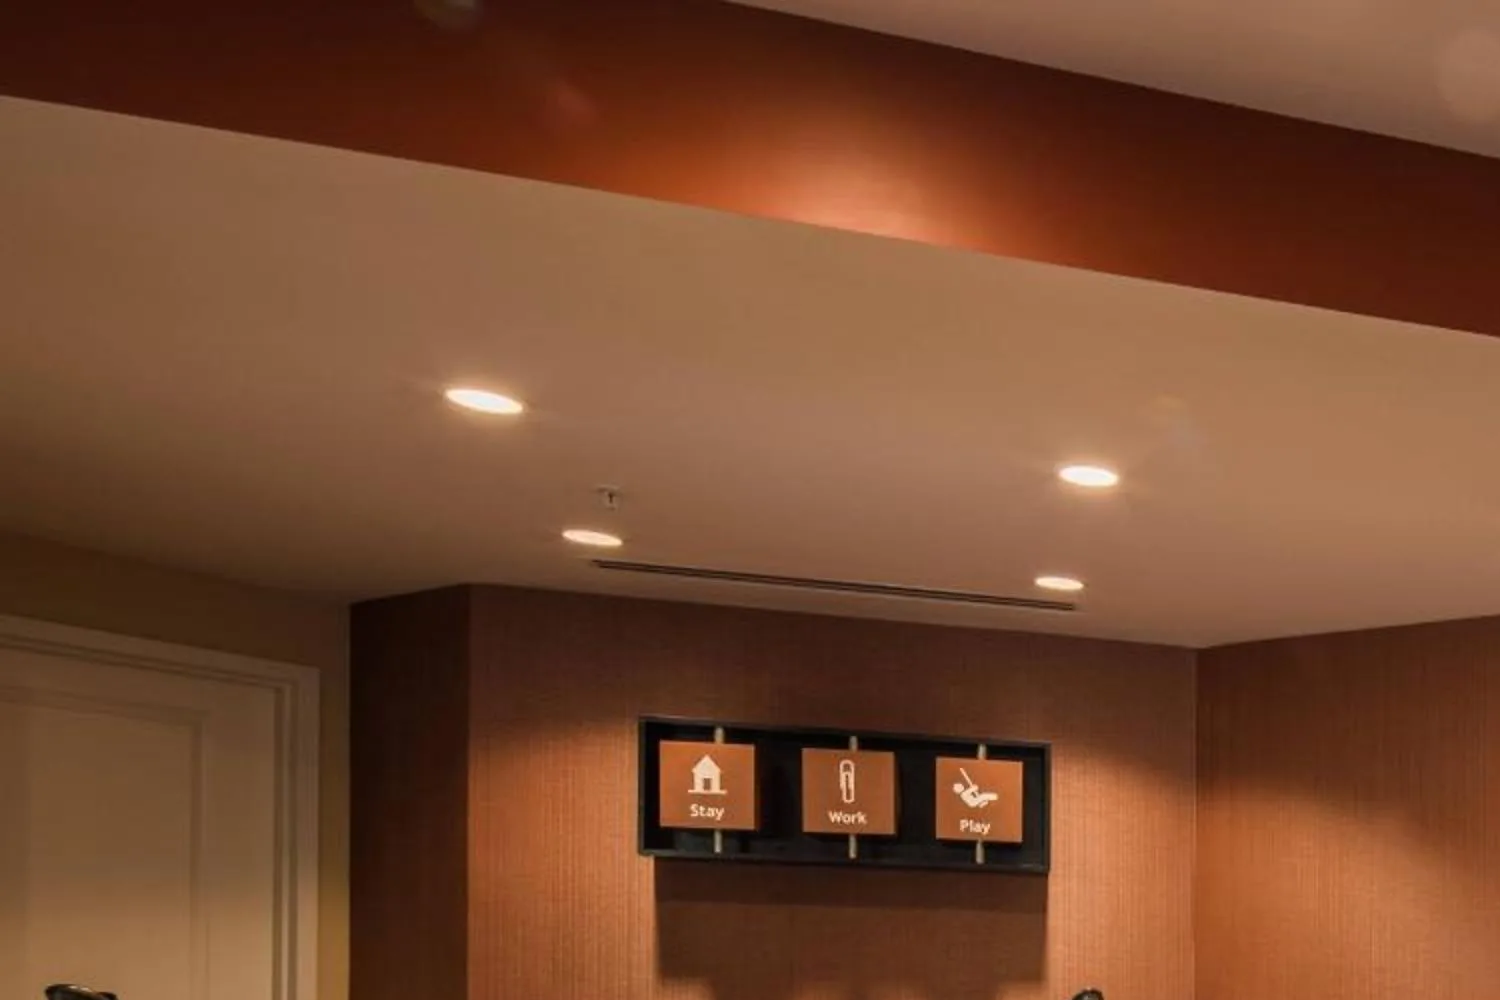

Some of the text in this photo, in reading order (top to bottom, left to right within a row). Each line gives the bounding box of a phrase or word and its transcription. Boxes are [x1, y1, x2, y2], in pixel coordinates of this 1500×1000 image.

[690, 803, 724, 820] Stay
[828, 810, 868, 825] Work
[959, 819, 991, 835] Play
